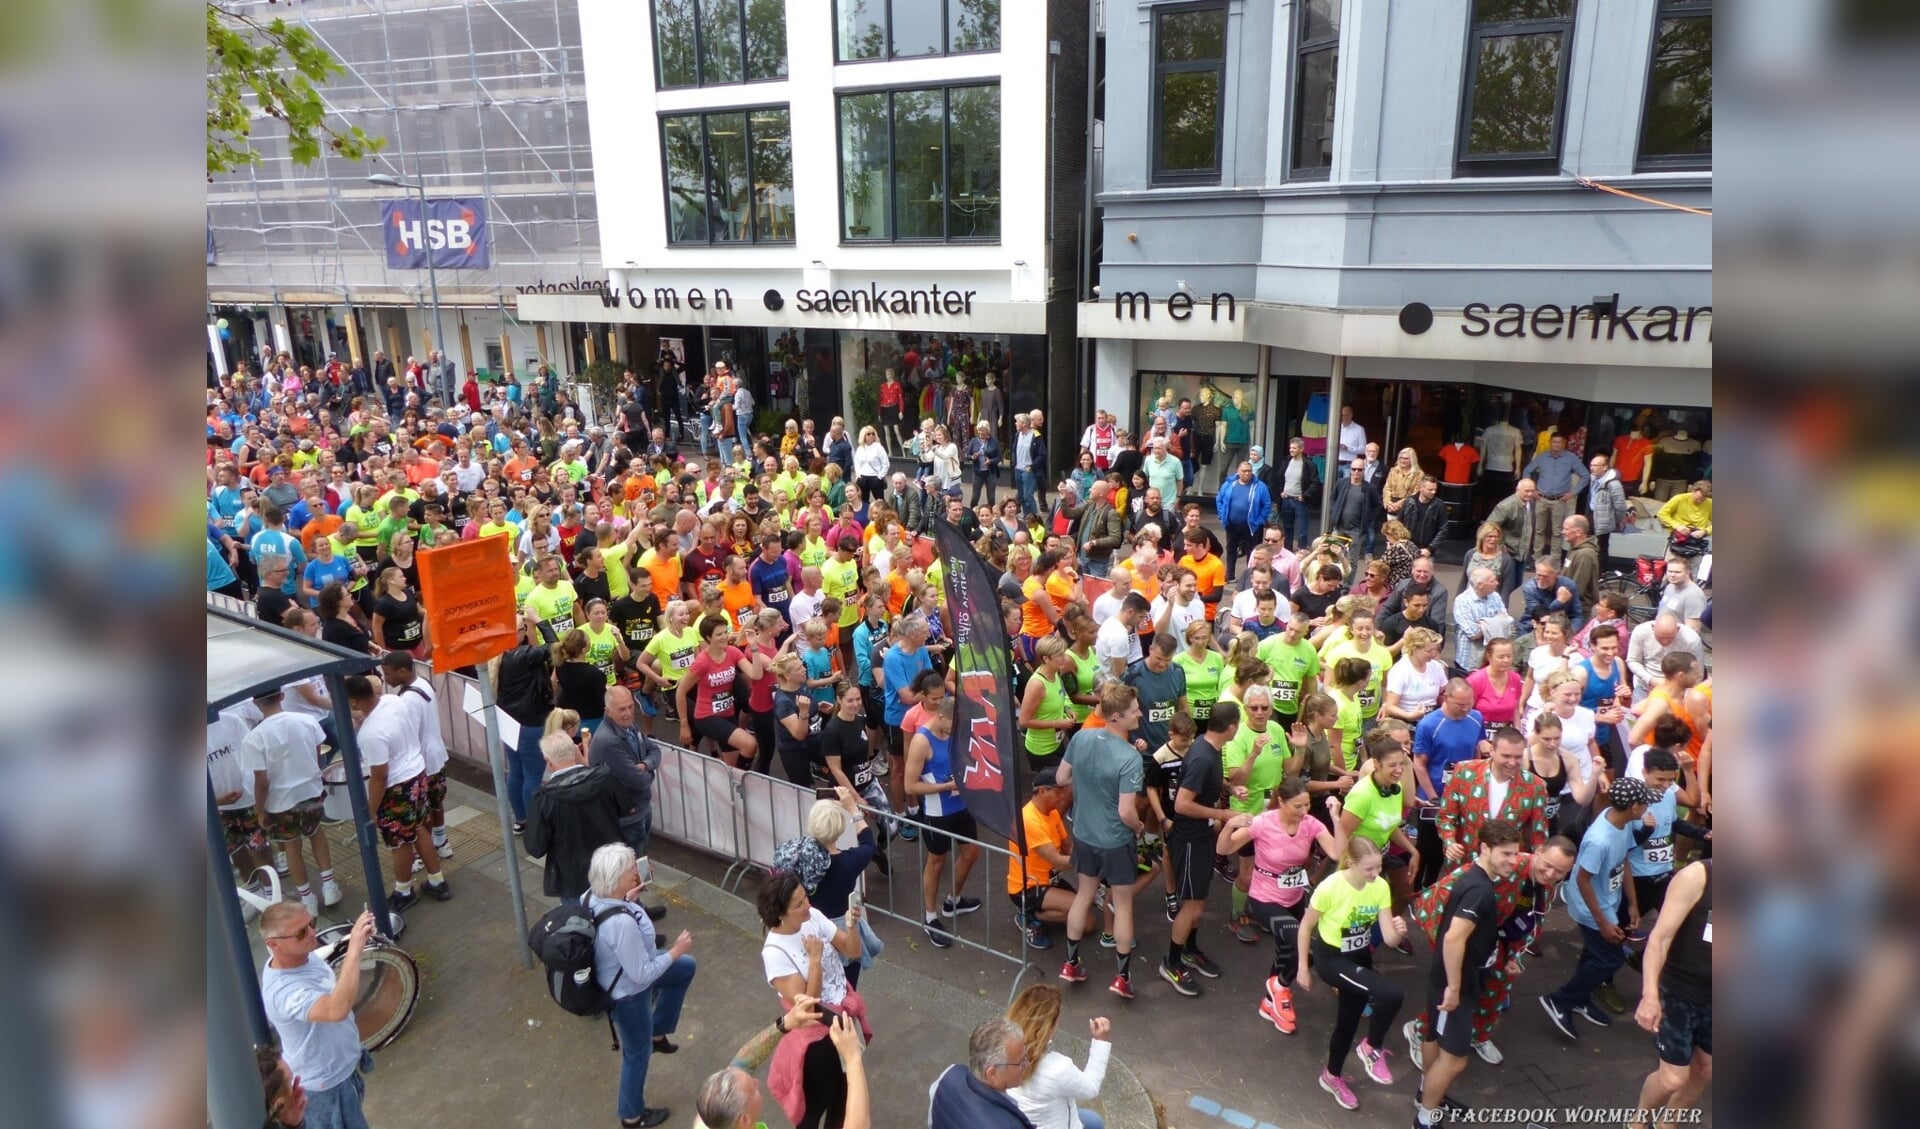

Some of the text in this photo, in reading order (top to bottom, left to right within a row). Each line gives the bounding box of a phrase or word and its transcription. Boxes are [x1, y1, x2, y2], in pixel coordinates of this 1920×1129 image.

[398, 219, 472, 250] HSB
[600, 282, 976, 315] women saenkanter
[1115, 290, 1712, 342] men saenkan
[771, 592, 787, 602] 955
[555, 621, 573, 633] 754
[679, 657, 690, 668] 81
[1273, 690, 1296, 700] 453
[1151, 709, 1174, 721] 943
[1282, 872, 1304, 887] 412
